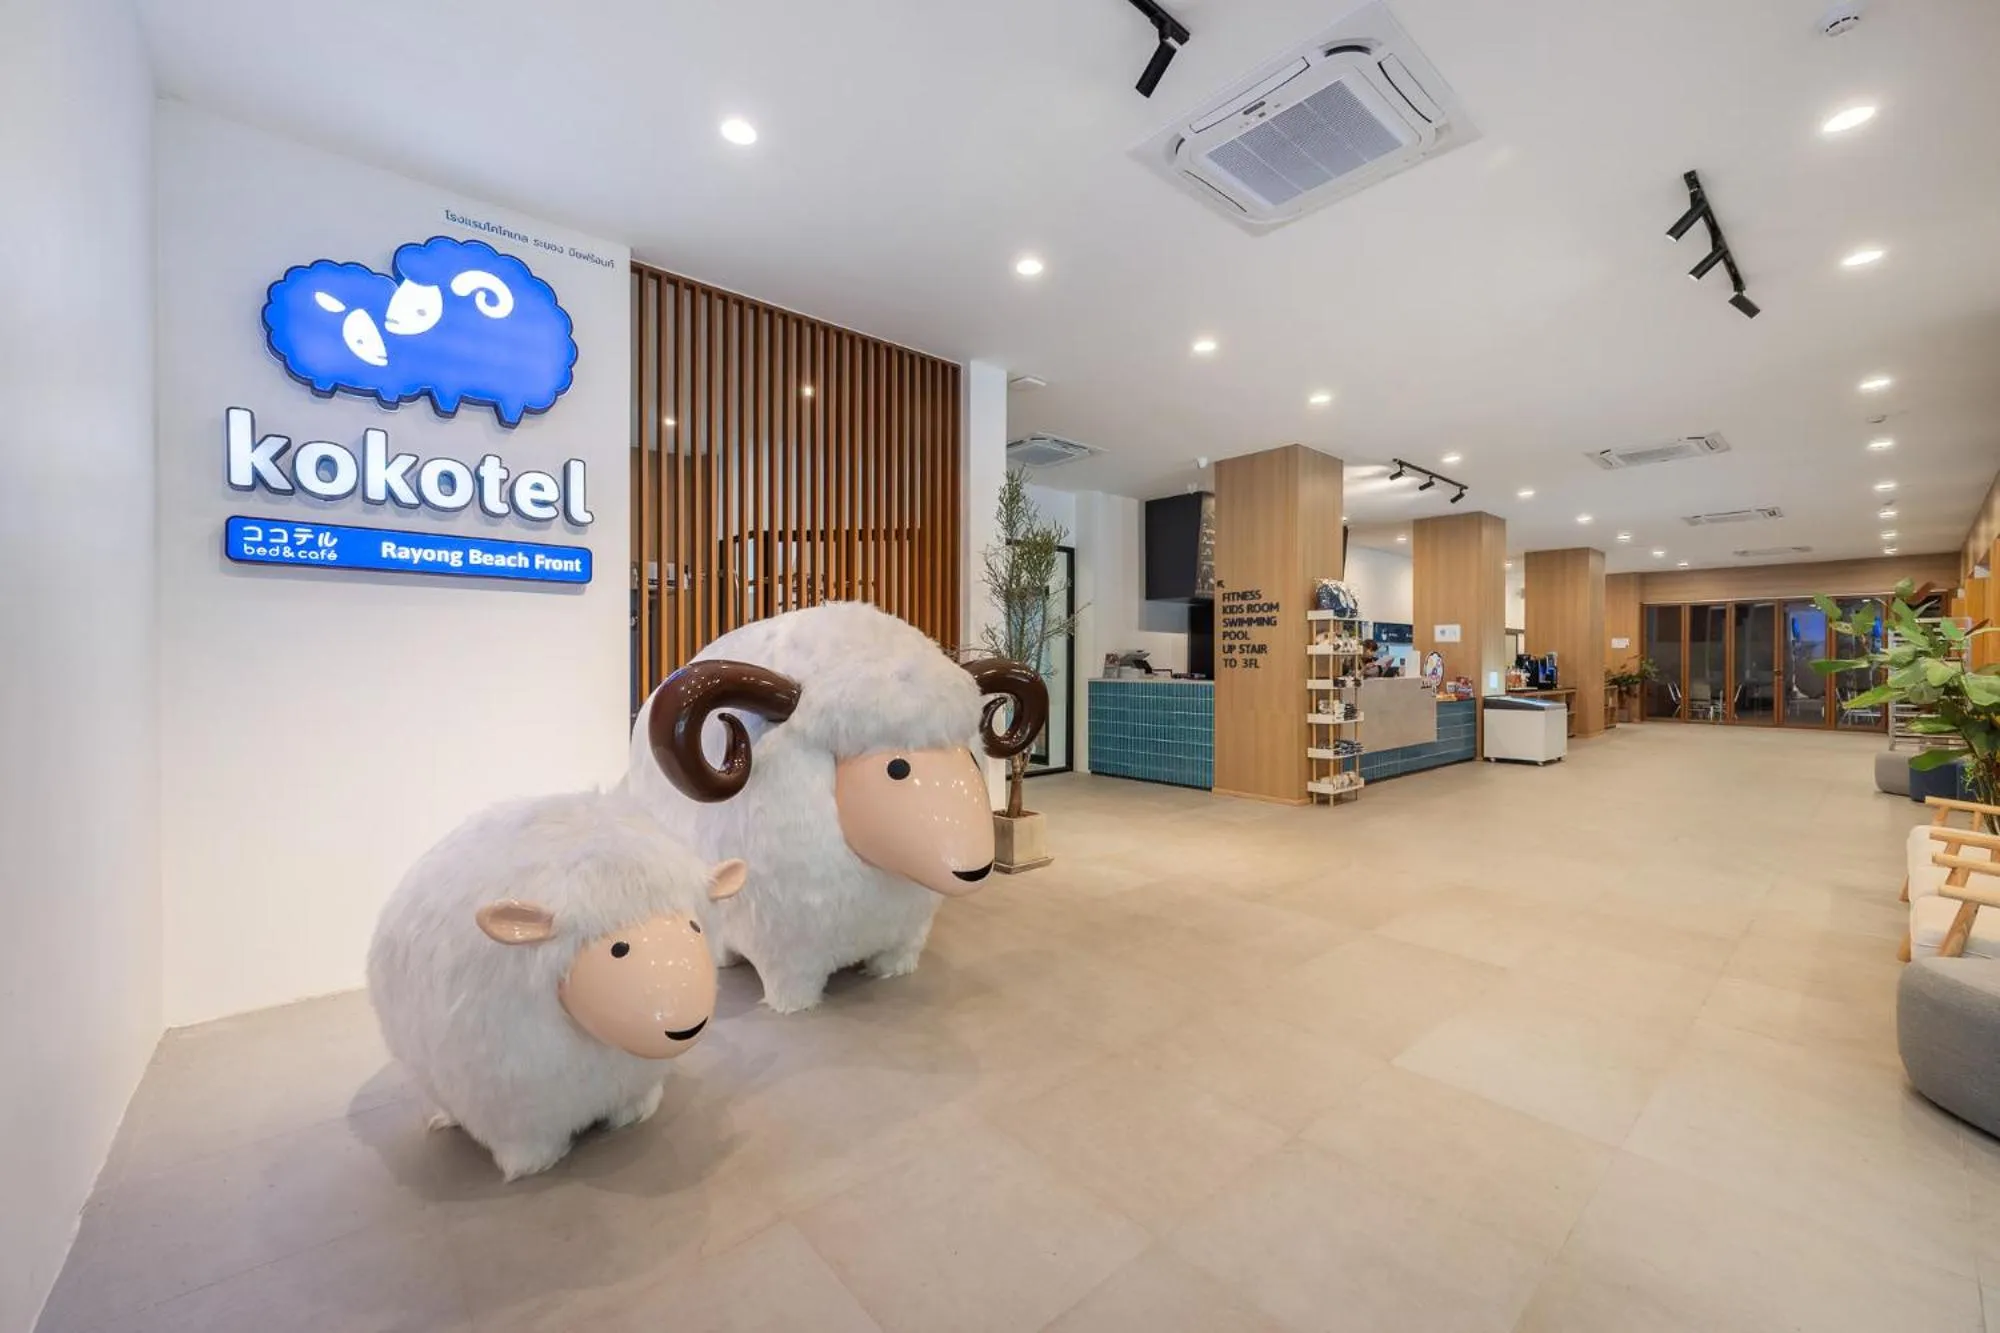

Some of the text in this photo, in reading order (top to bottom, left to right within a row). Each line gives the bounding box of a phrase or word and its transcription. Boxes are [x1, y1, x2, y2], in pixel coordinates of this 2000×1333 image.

[226, 407, 594, 526] kokotel
[243, 526, 338, 547] ココテル
[381, 541, 582, 572] Rayong Beach Front
[1222, 590, 1262, 602] FITNESS
[1222, 602, 1279, 614] KIDS ROOM
[1222, 616, 1277, 628] SWIMMING
[1222, 630, 1250, 641] POOL
[1222, 644, 1268, 654] UP STAIR
[1223, 658, 1260, 669] TO 3FL
